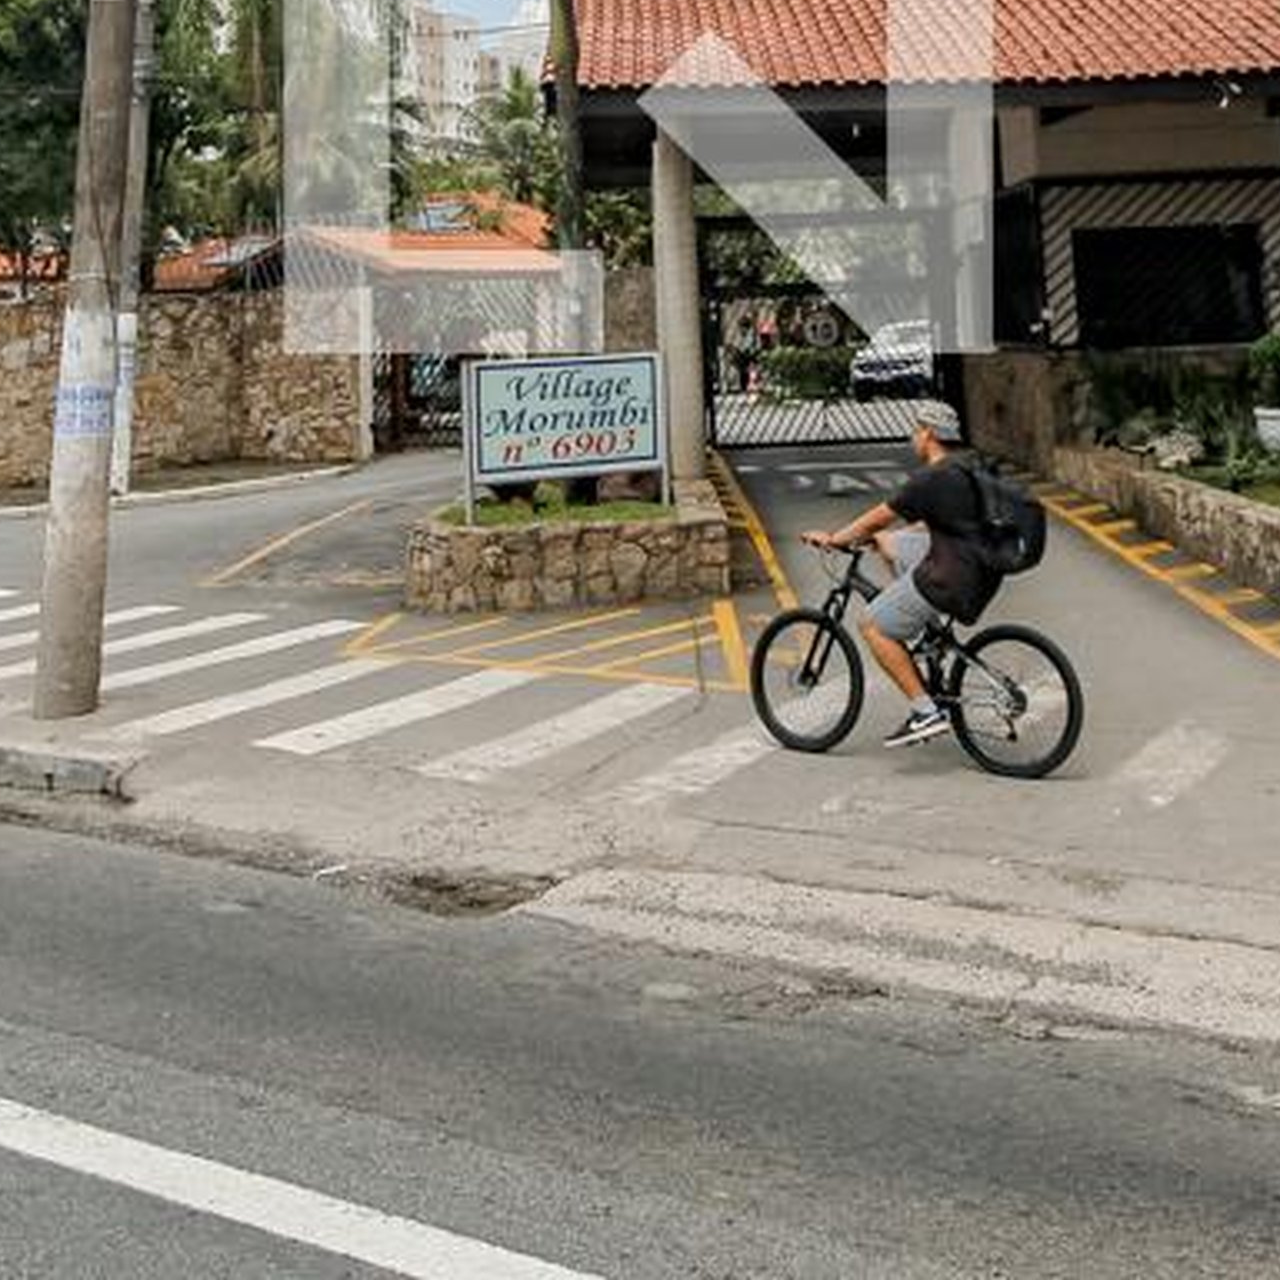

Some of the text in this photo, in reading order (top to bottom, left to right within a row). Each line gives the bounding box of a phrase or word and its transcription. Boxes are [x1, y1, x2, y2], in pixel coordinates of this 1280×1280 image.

[505, 369, 631, 407] Village
[484, 396, 649, 438] Morumbi
[552, 428, 635, 460] 6903
